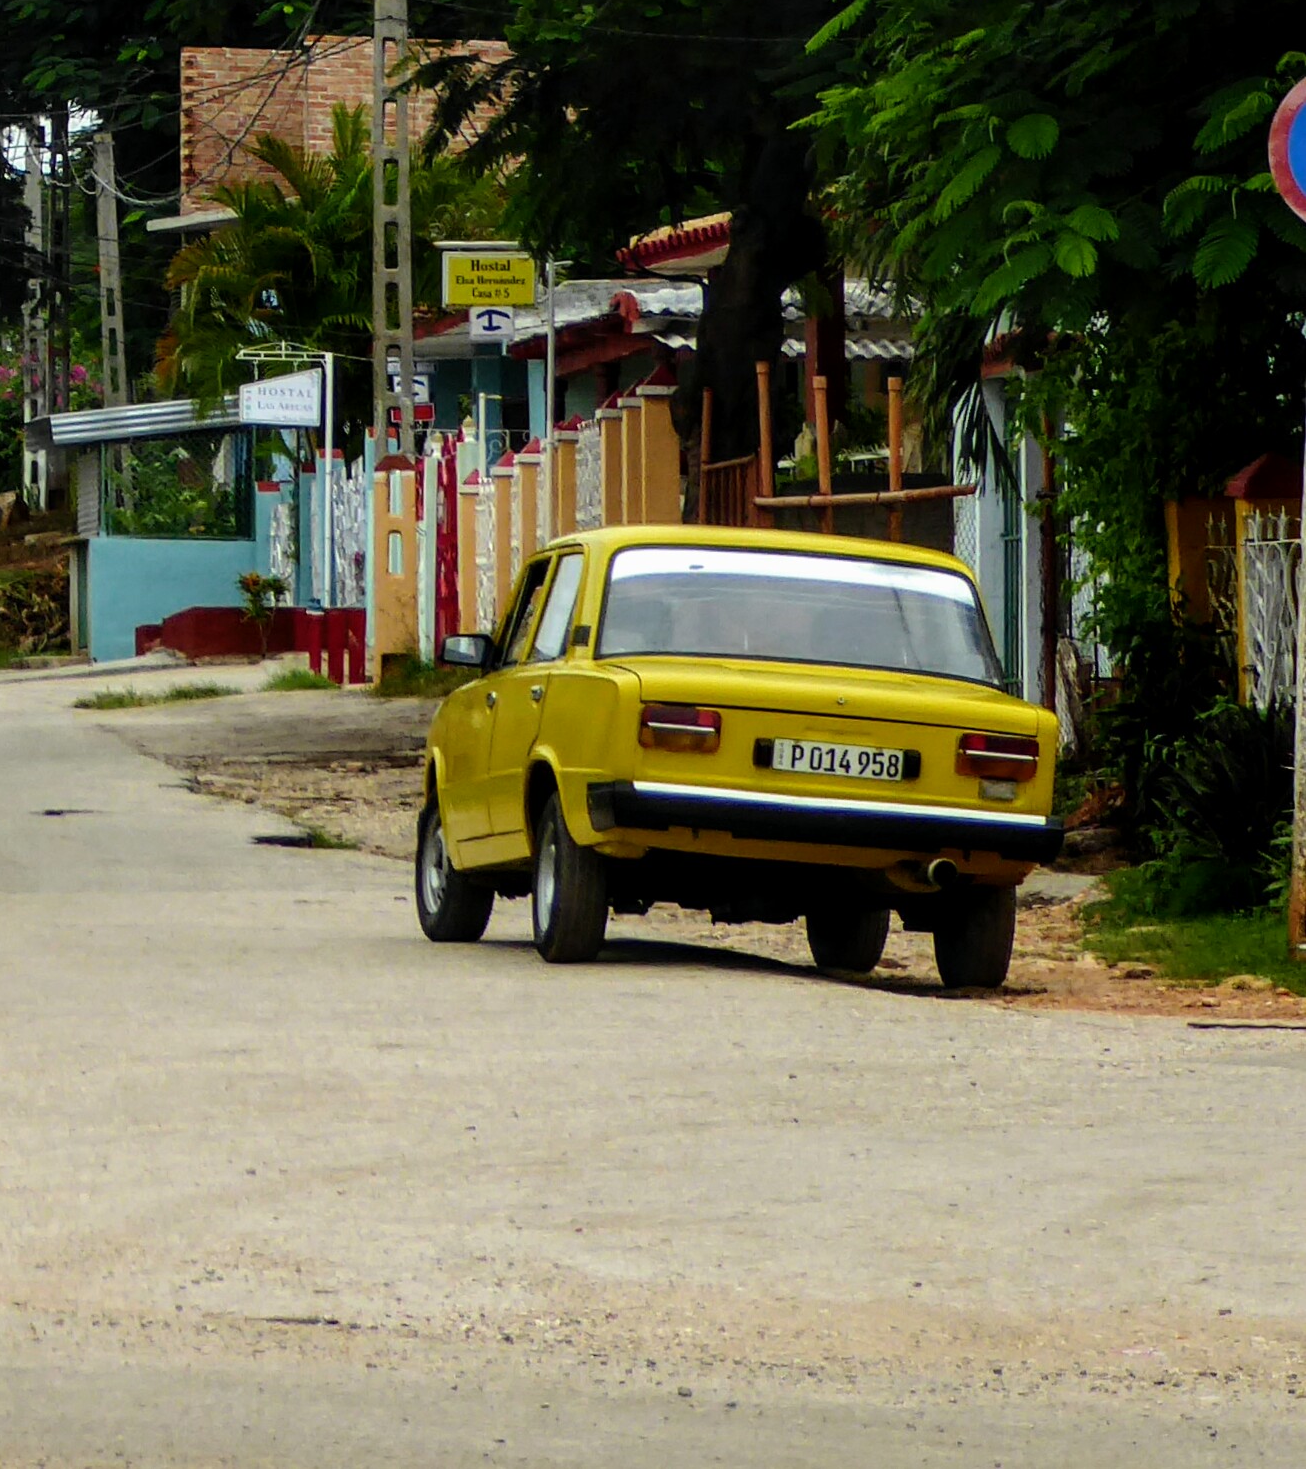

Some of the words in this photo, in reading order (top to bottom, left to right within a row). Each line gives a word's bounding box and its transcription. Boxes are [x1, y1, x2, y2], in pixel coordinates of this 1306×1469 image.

[471, 259, 511, 272] Hostal
[472, 287, 492, 298] Casa
[258, 386, 314, 399] HOSTAL
